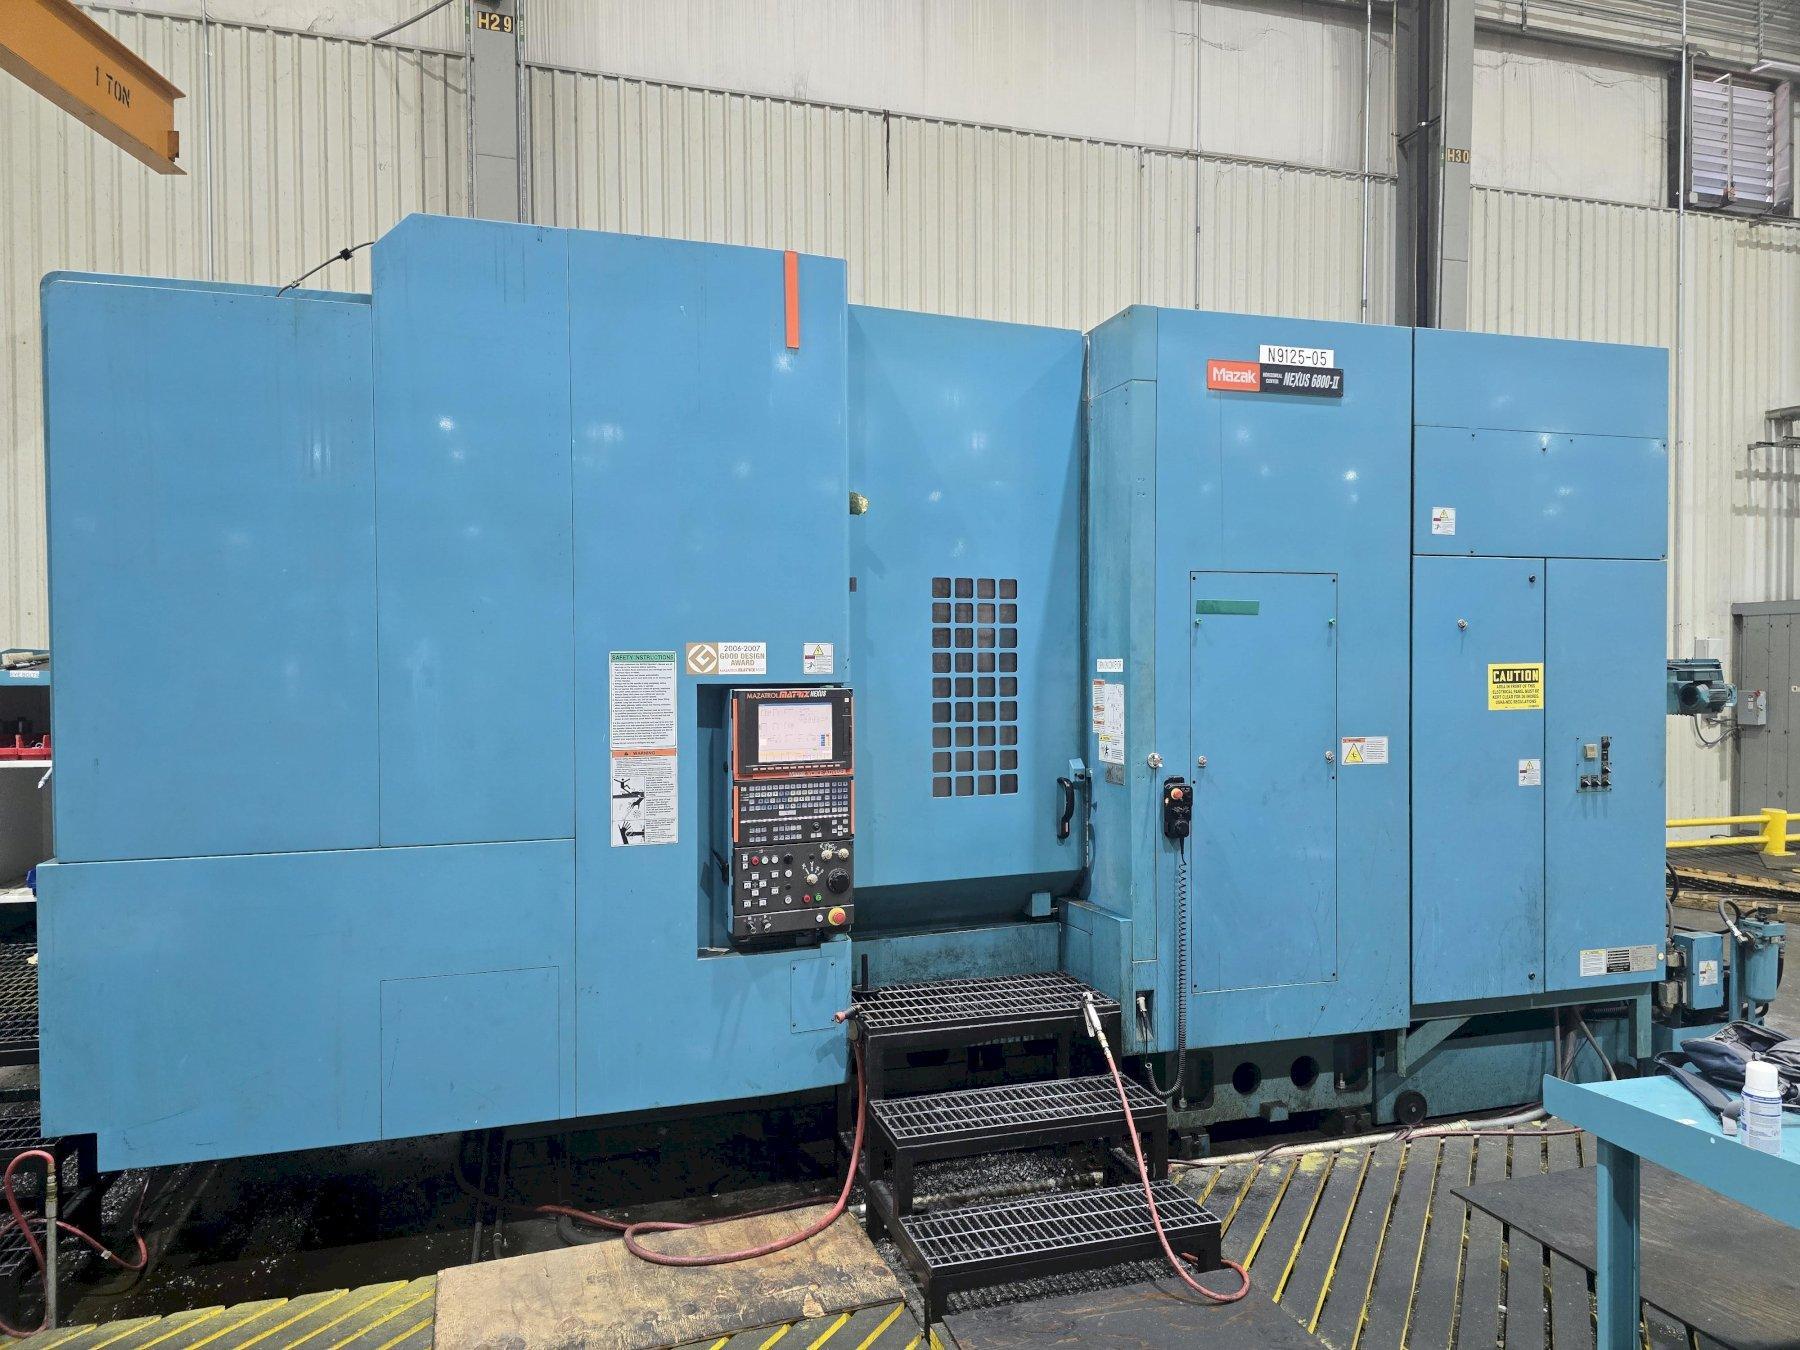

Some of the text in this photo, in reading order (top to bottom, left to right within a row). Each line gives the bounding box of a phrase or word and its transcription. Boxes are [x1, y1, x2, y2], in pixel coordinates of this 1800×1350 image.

[478, 11, 512, 33] H29
[96, 66, 130, 108] 1 TON
[1447, 148, 1469, 163] H30
[1268, 347, 1327, 366] N9125-05
[1212, 366, 1257, 384] Mazak
[1283, 371, 1340, 389] NEXUS 6800-II
[1493, 669, 1538, 682] CAUTION
[746, 690, 826, 699] MAZATROL MATRIX NEXUS
